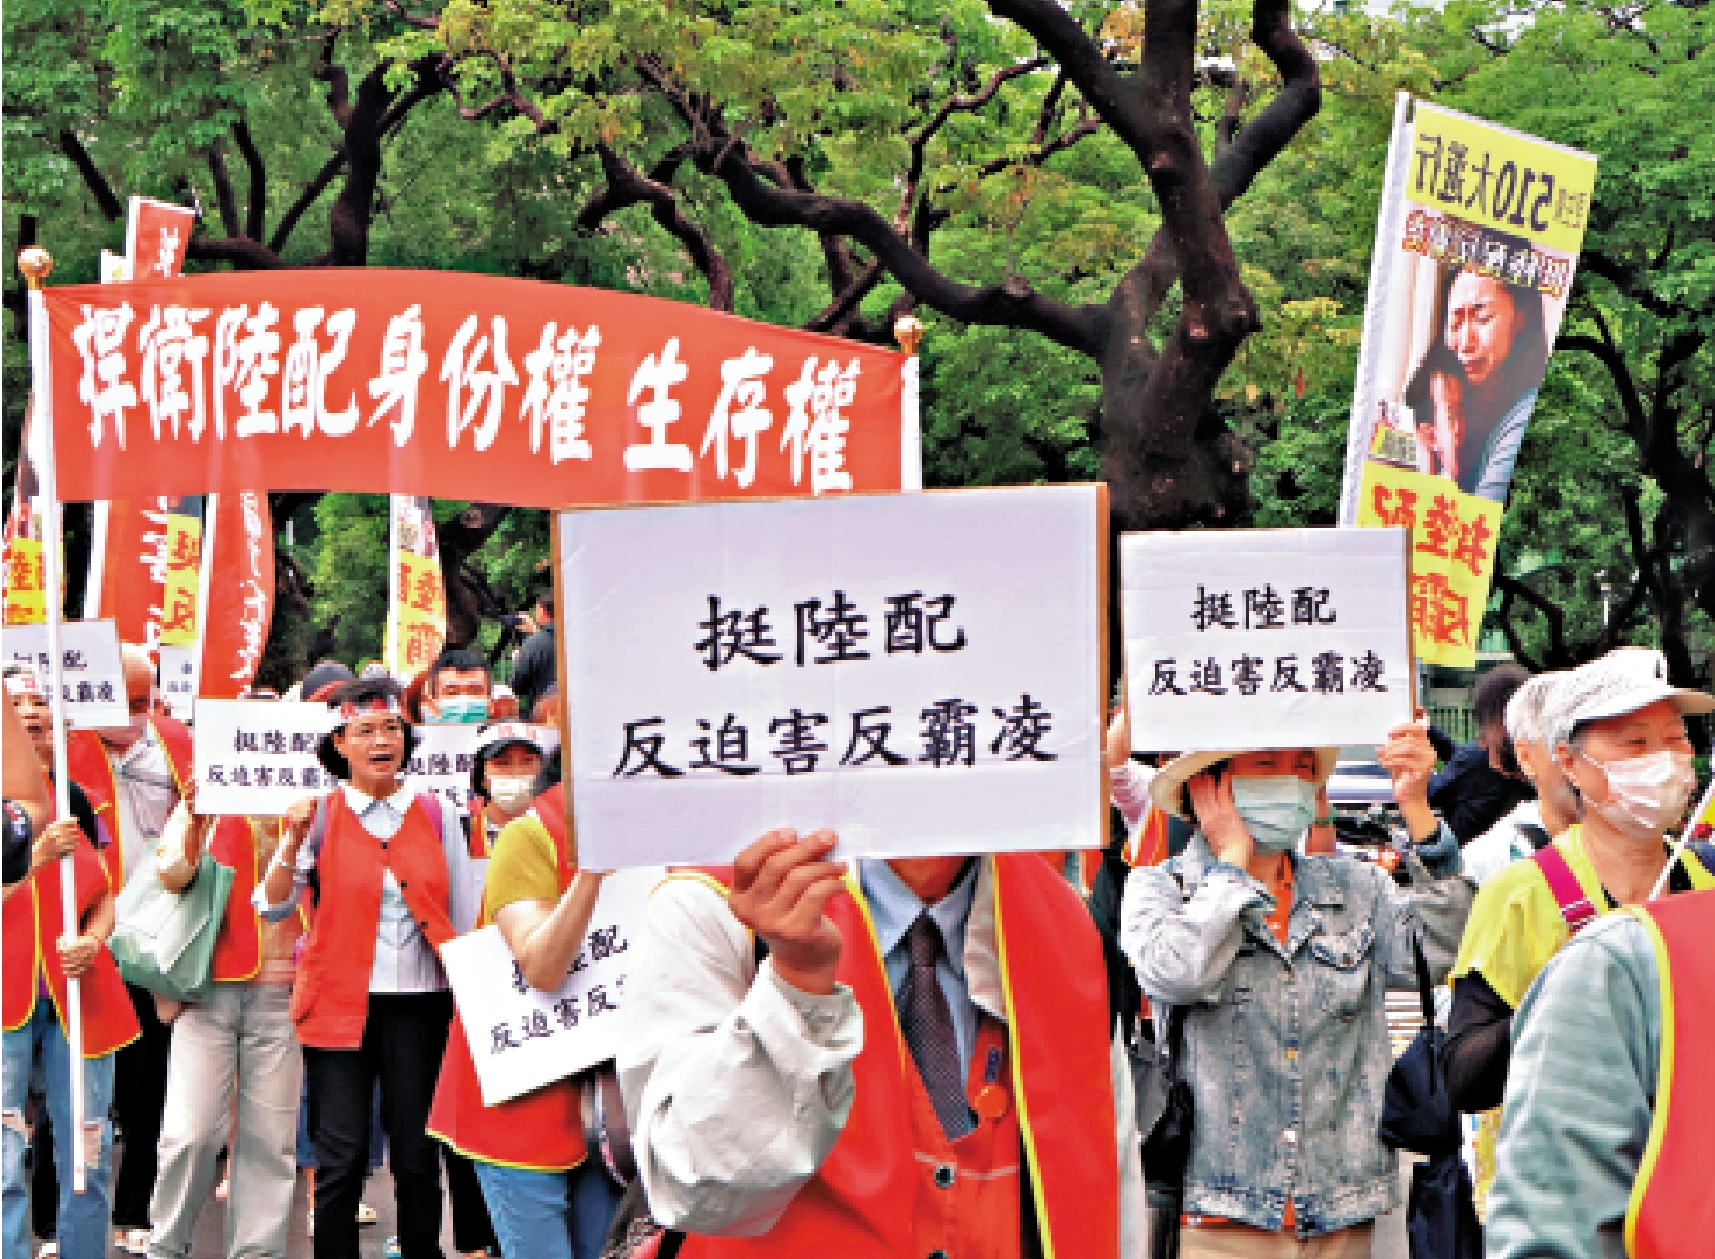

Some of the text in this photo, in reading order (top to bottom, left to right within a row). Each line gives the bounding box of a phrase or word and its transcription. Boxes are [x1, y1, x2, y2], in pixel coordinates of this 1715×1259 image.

[73, 302, 861, 497] 捍衛陸配身份權 生存權
[695, 590, 967, 671] 挺陸配
[1190, 586, 1337, 630] 挺陸配
[1148, 650, 1389, 695] 反迫害反霸凌
[613, 693, 1058, 778] 反迫害反霸凌
[490, 973, 627, 1055] 反迫害反
